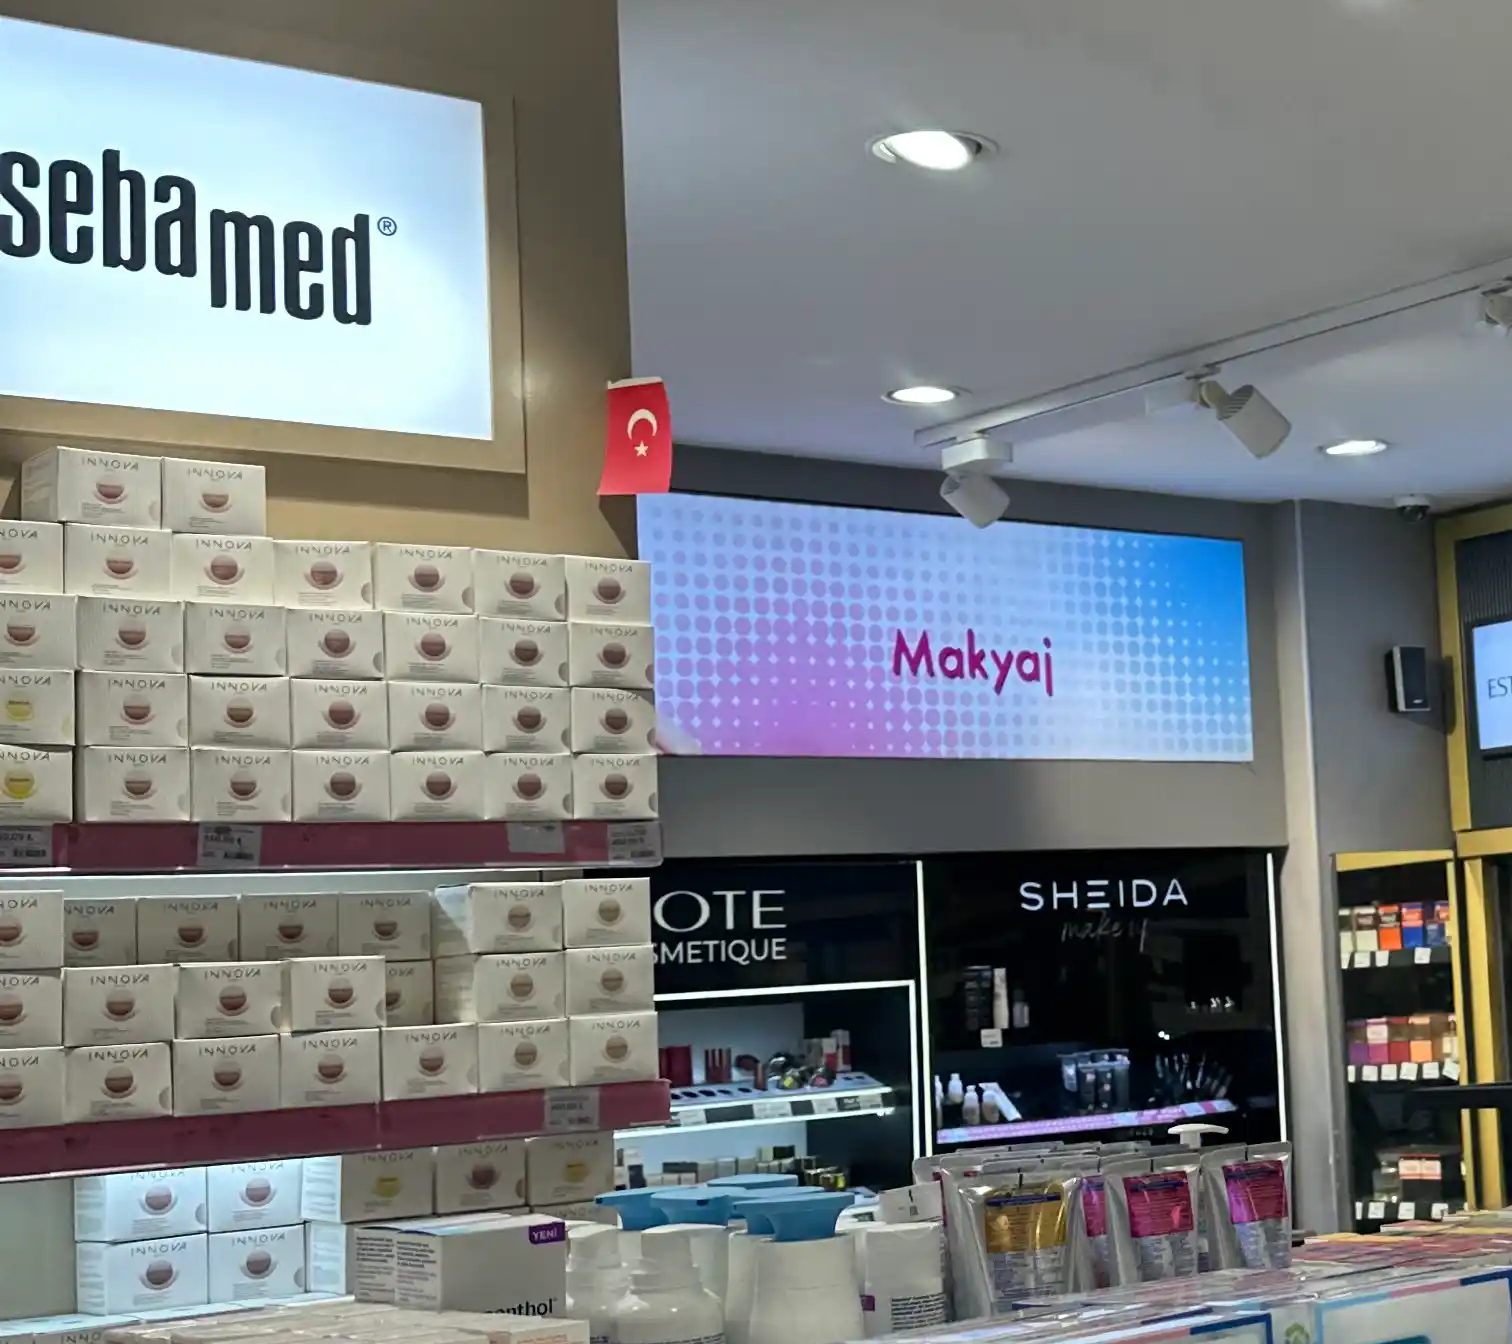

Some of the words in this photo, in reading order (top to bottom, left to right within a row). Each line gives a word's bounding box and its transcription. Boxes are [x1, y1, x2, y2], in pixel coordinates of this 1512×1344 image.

[892, 628, 1054, 697] Makyaj
[64, 905, 115, 915] NNOVA
[654, 889, 787, 932] OTE
[1019, 878, 1189, 913] SHEIDA
